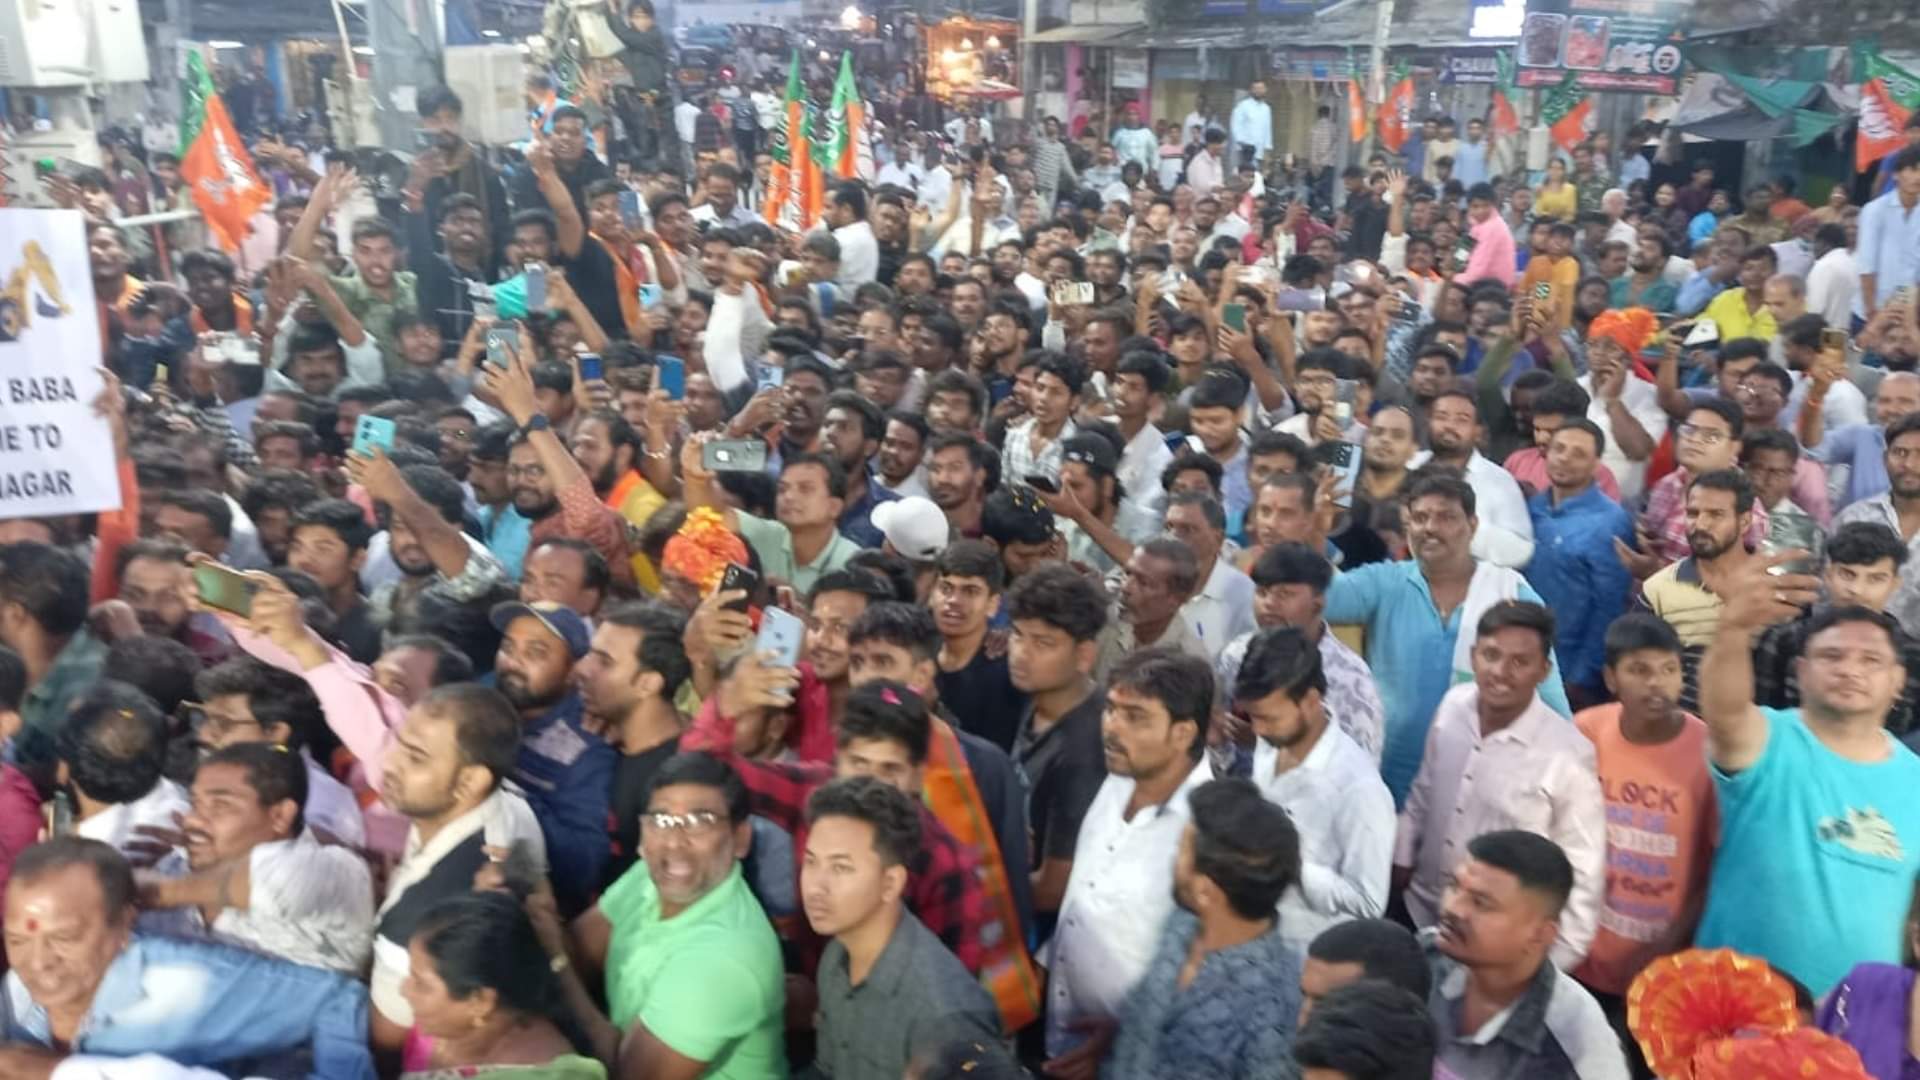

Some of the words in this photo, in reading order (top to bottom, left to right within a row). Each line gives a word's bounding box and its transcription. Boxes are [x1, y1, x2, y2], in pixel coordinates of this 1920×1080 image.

[8, 376, 77, 404] BABA
[0, 425, 22, 451] E
[27, 422, 62, 449] TO
[0, 469, 73, 499] AGAR
[1599, 776, 1679, 814] LOCK
